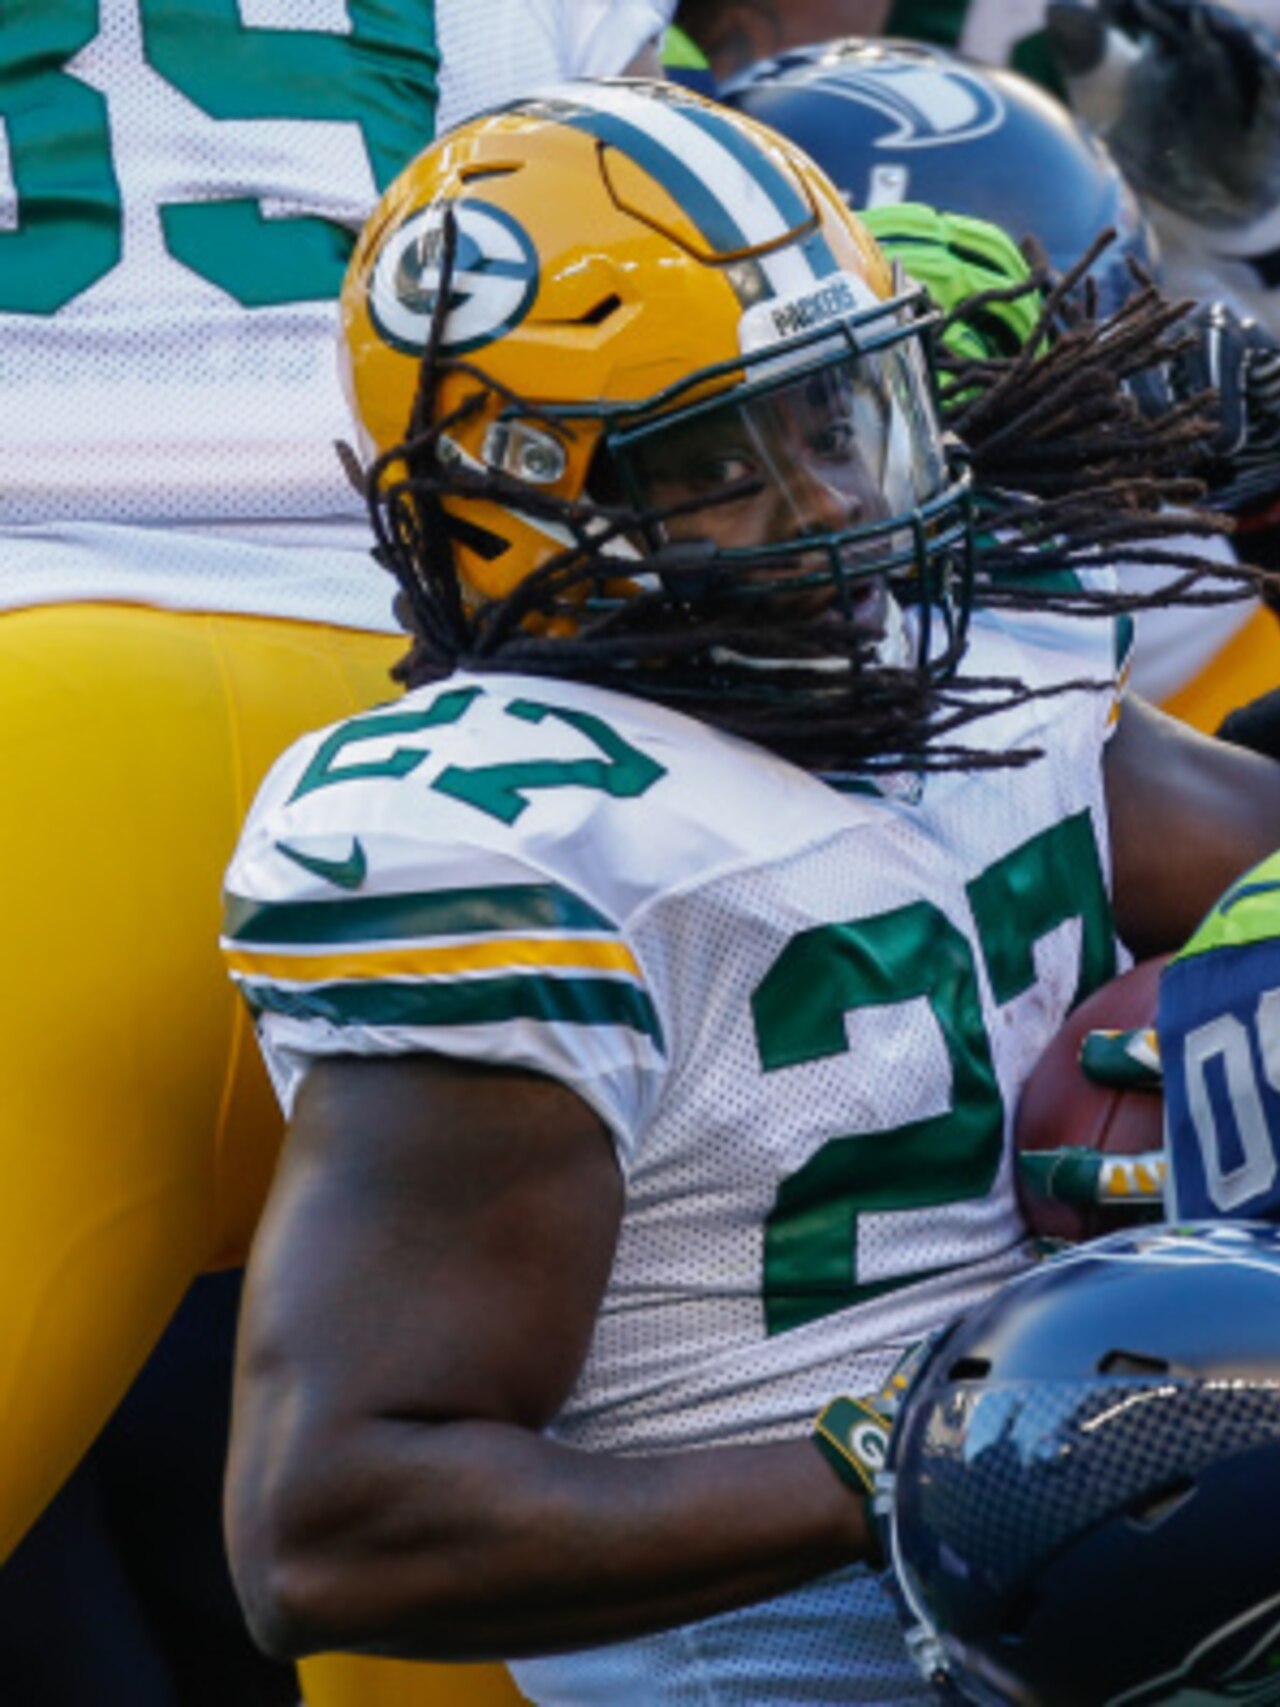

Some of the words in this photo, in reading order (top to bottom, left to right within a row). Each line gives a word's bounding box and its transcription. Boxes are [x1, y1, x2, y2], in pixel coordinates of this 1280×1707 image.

[771, 281, 857, 337] PACKERS
[285, 684, 669, 828] 27
[750, 806, 1119, 1337] 27
